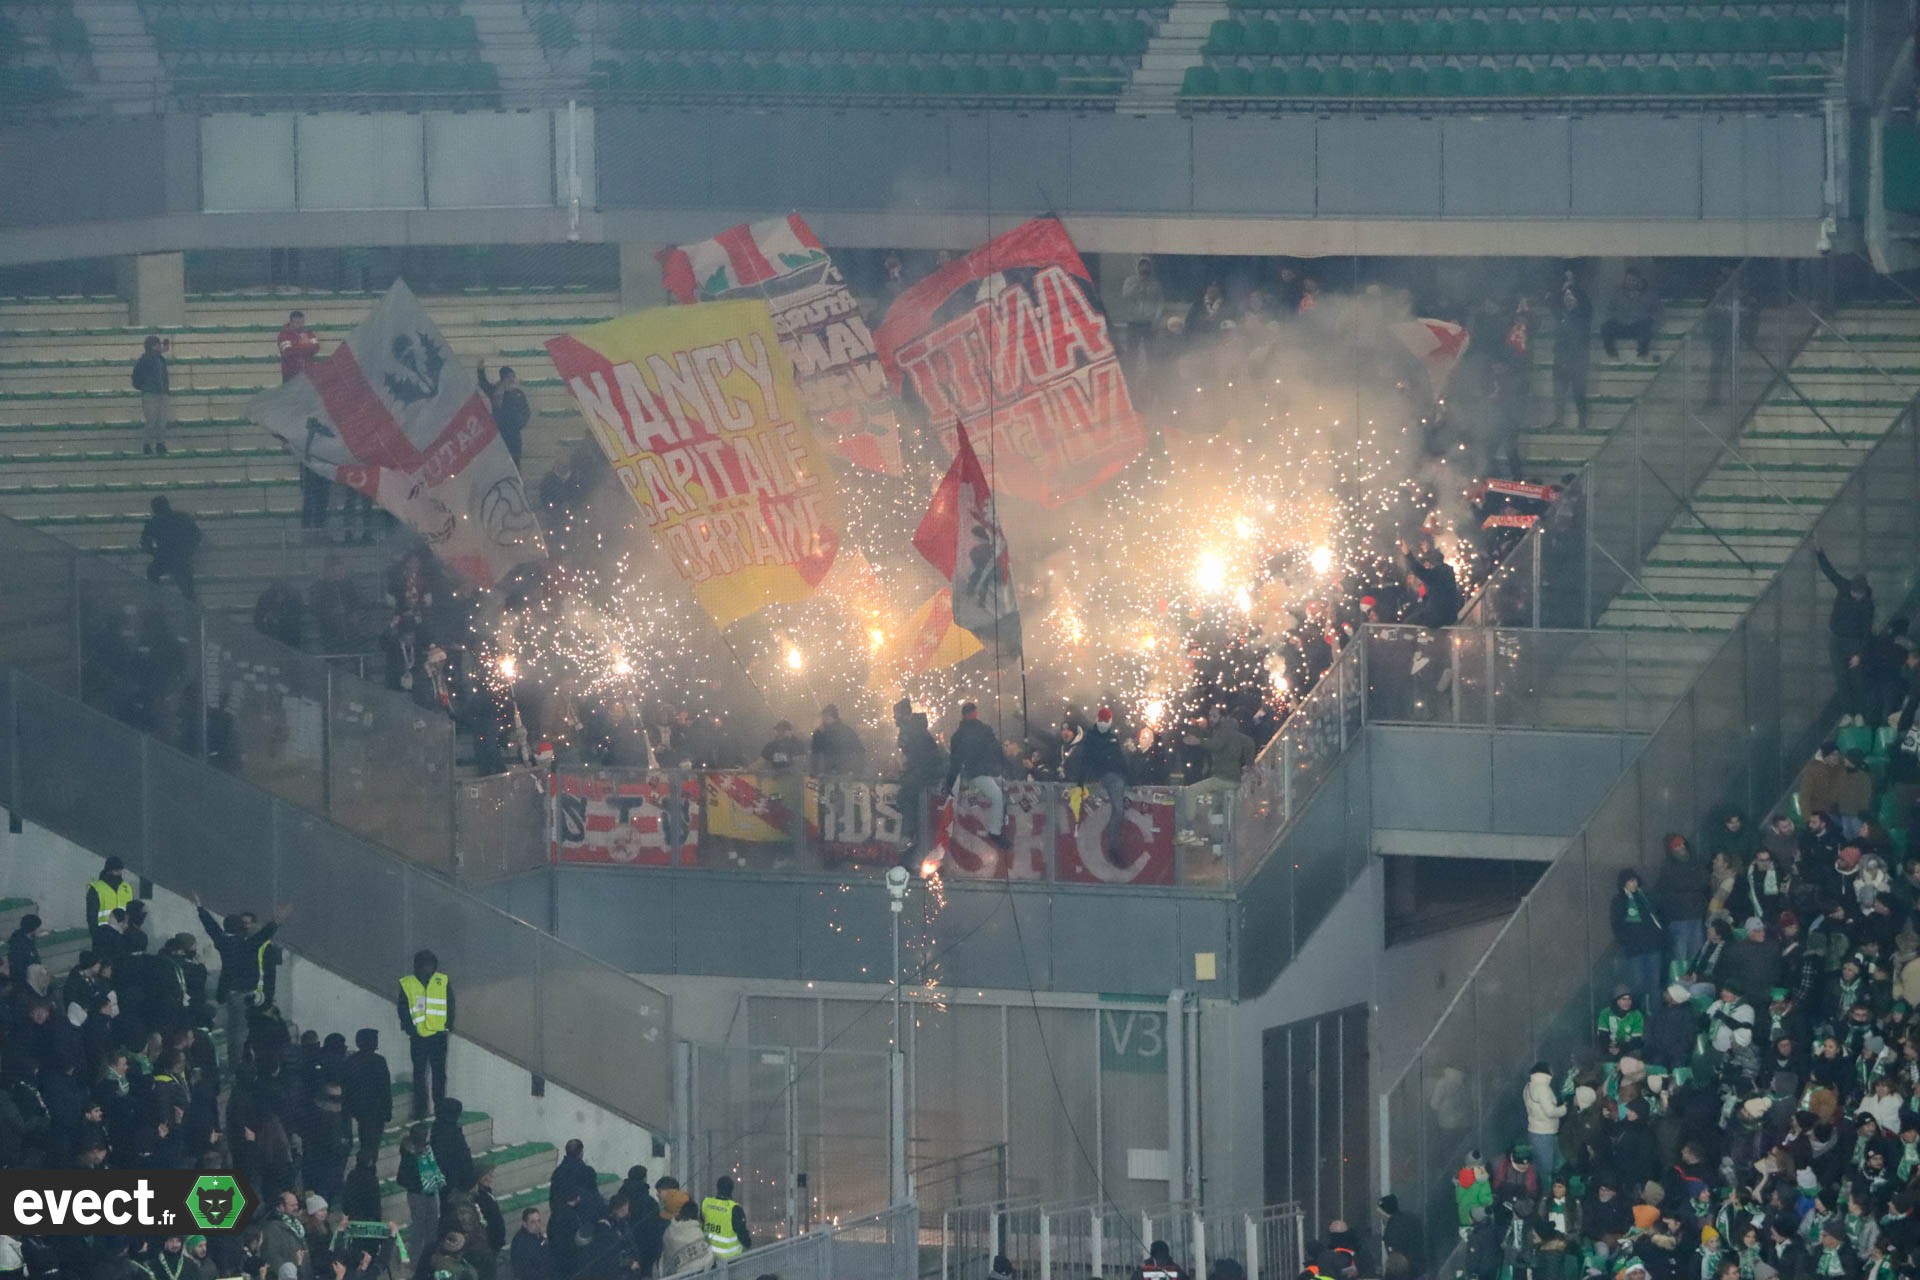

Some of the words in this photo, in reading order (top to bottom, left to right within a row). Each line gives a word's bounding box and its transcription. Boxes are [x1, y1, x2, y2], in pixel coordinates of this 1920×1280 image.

[569, 333, 779, 463] NANCY
[616, 422, 819, 526] CAPITALE
[1104, 1009, 1163, 1057] V3
